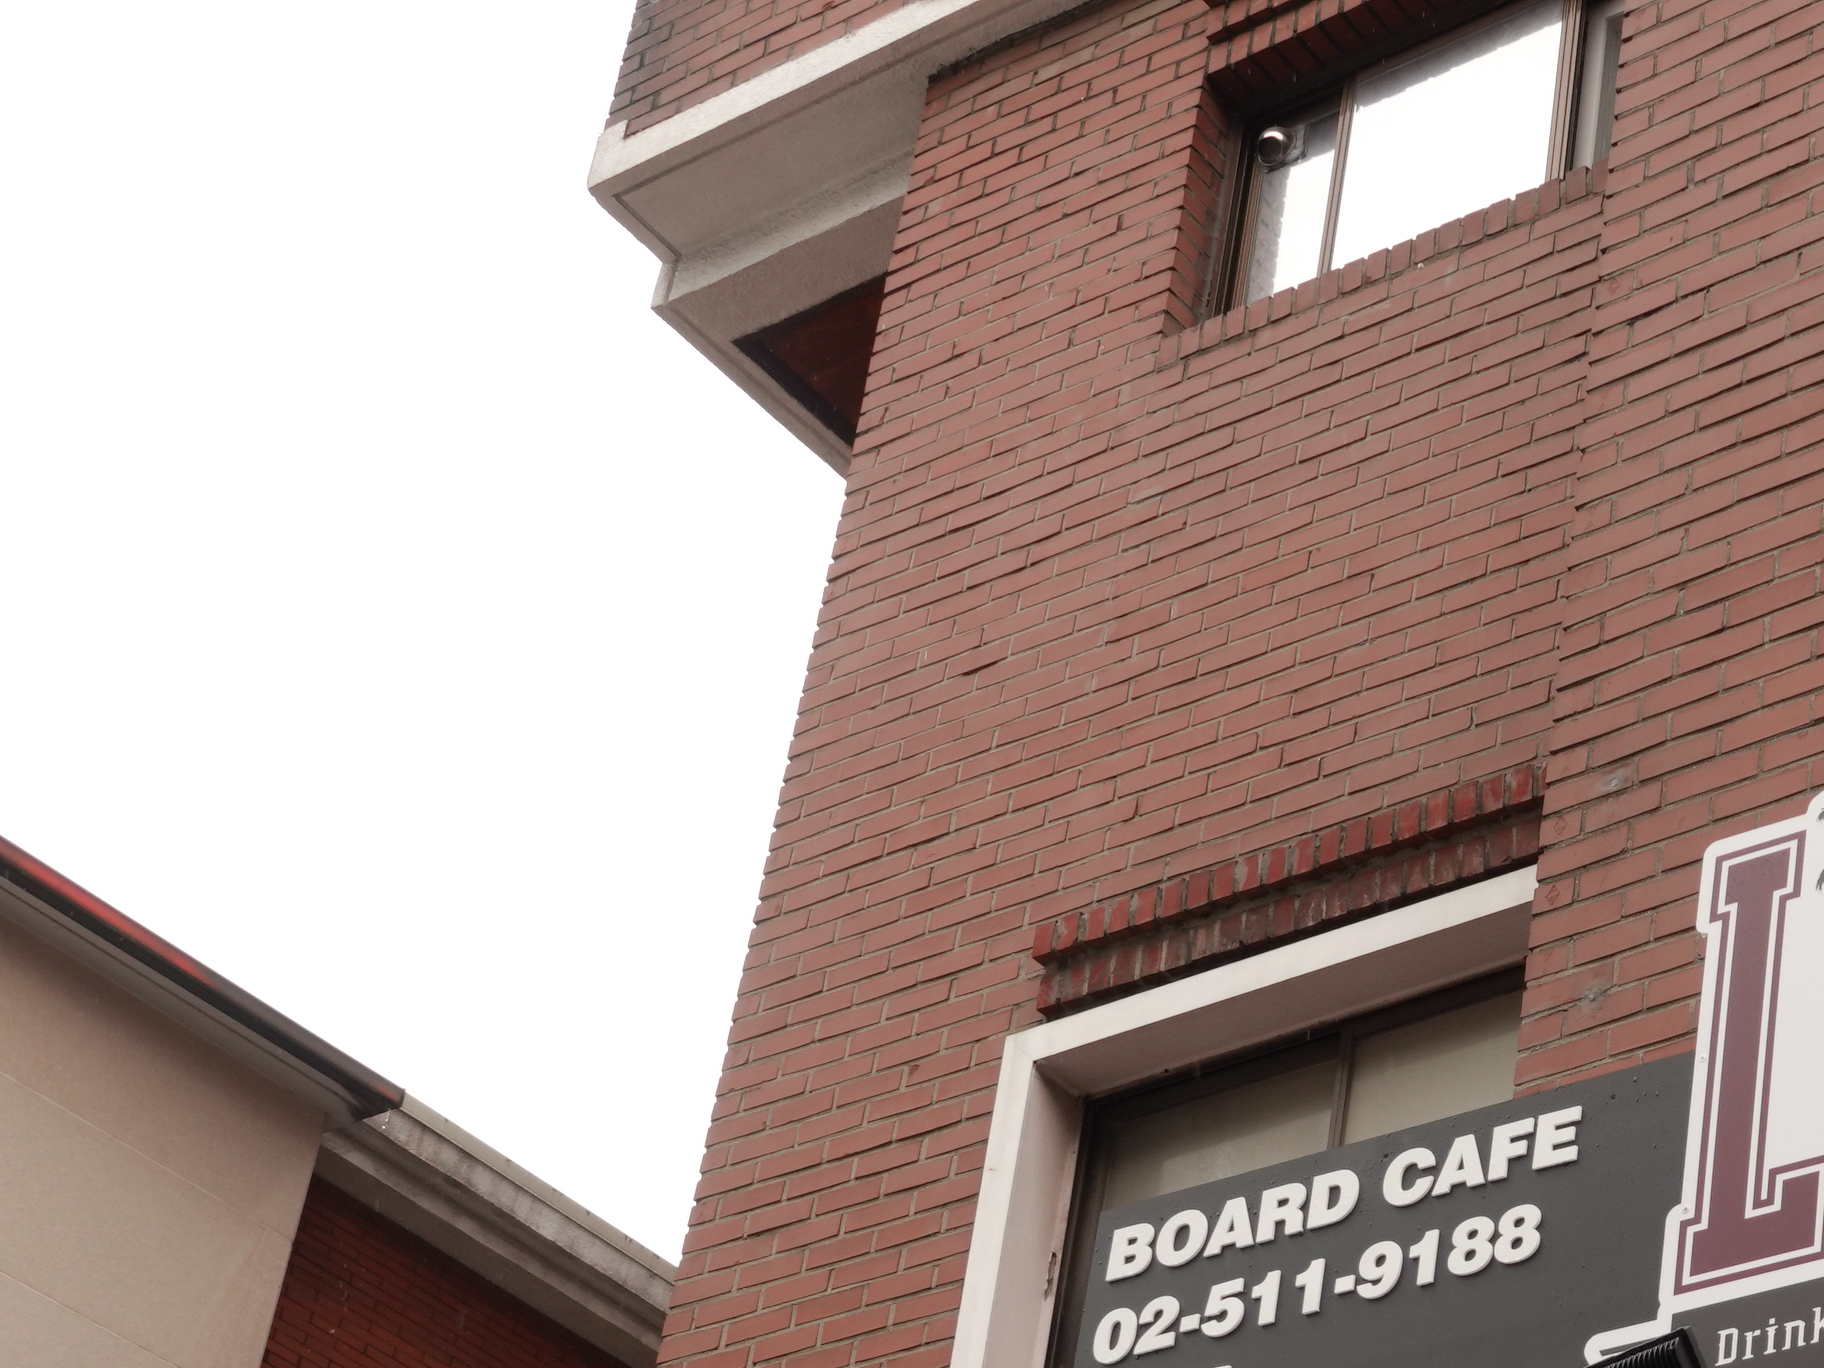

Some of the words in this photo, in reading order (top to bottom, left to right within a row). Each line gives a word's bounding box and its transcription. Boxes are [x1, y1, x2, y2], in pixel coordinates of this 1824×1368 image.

[1105, 1168, 1360, 1283] BOARD
[1383, 1105, 1583, 1208] CAFE
[1093, 1204, 1542, 1365] 02-511-9188
